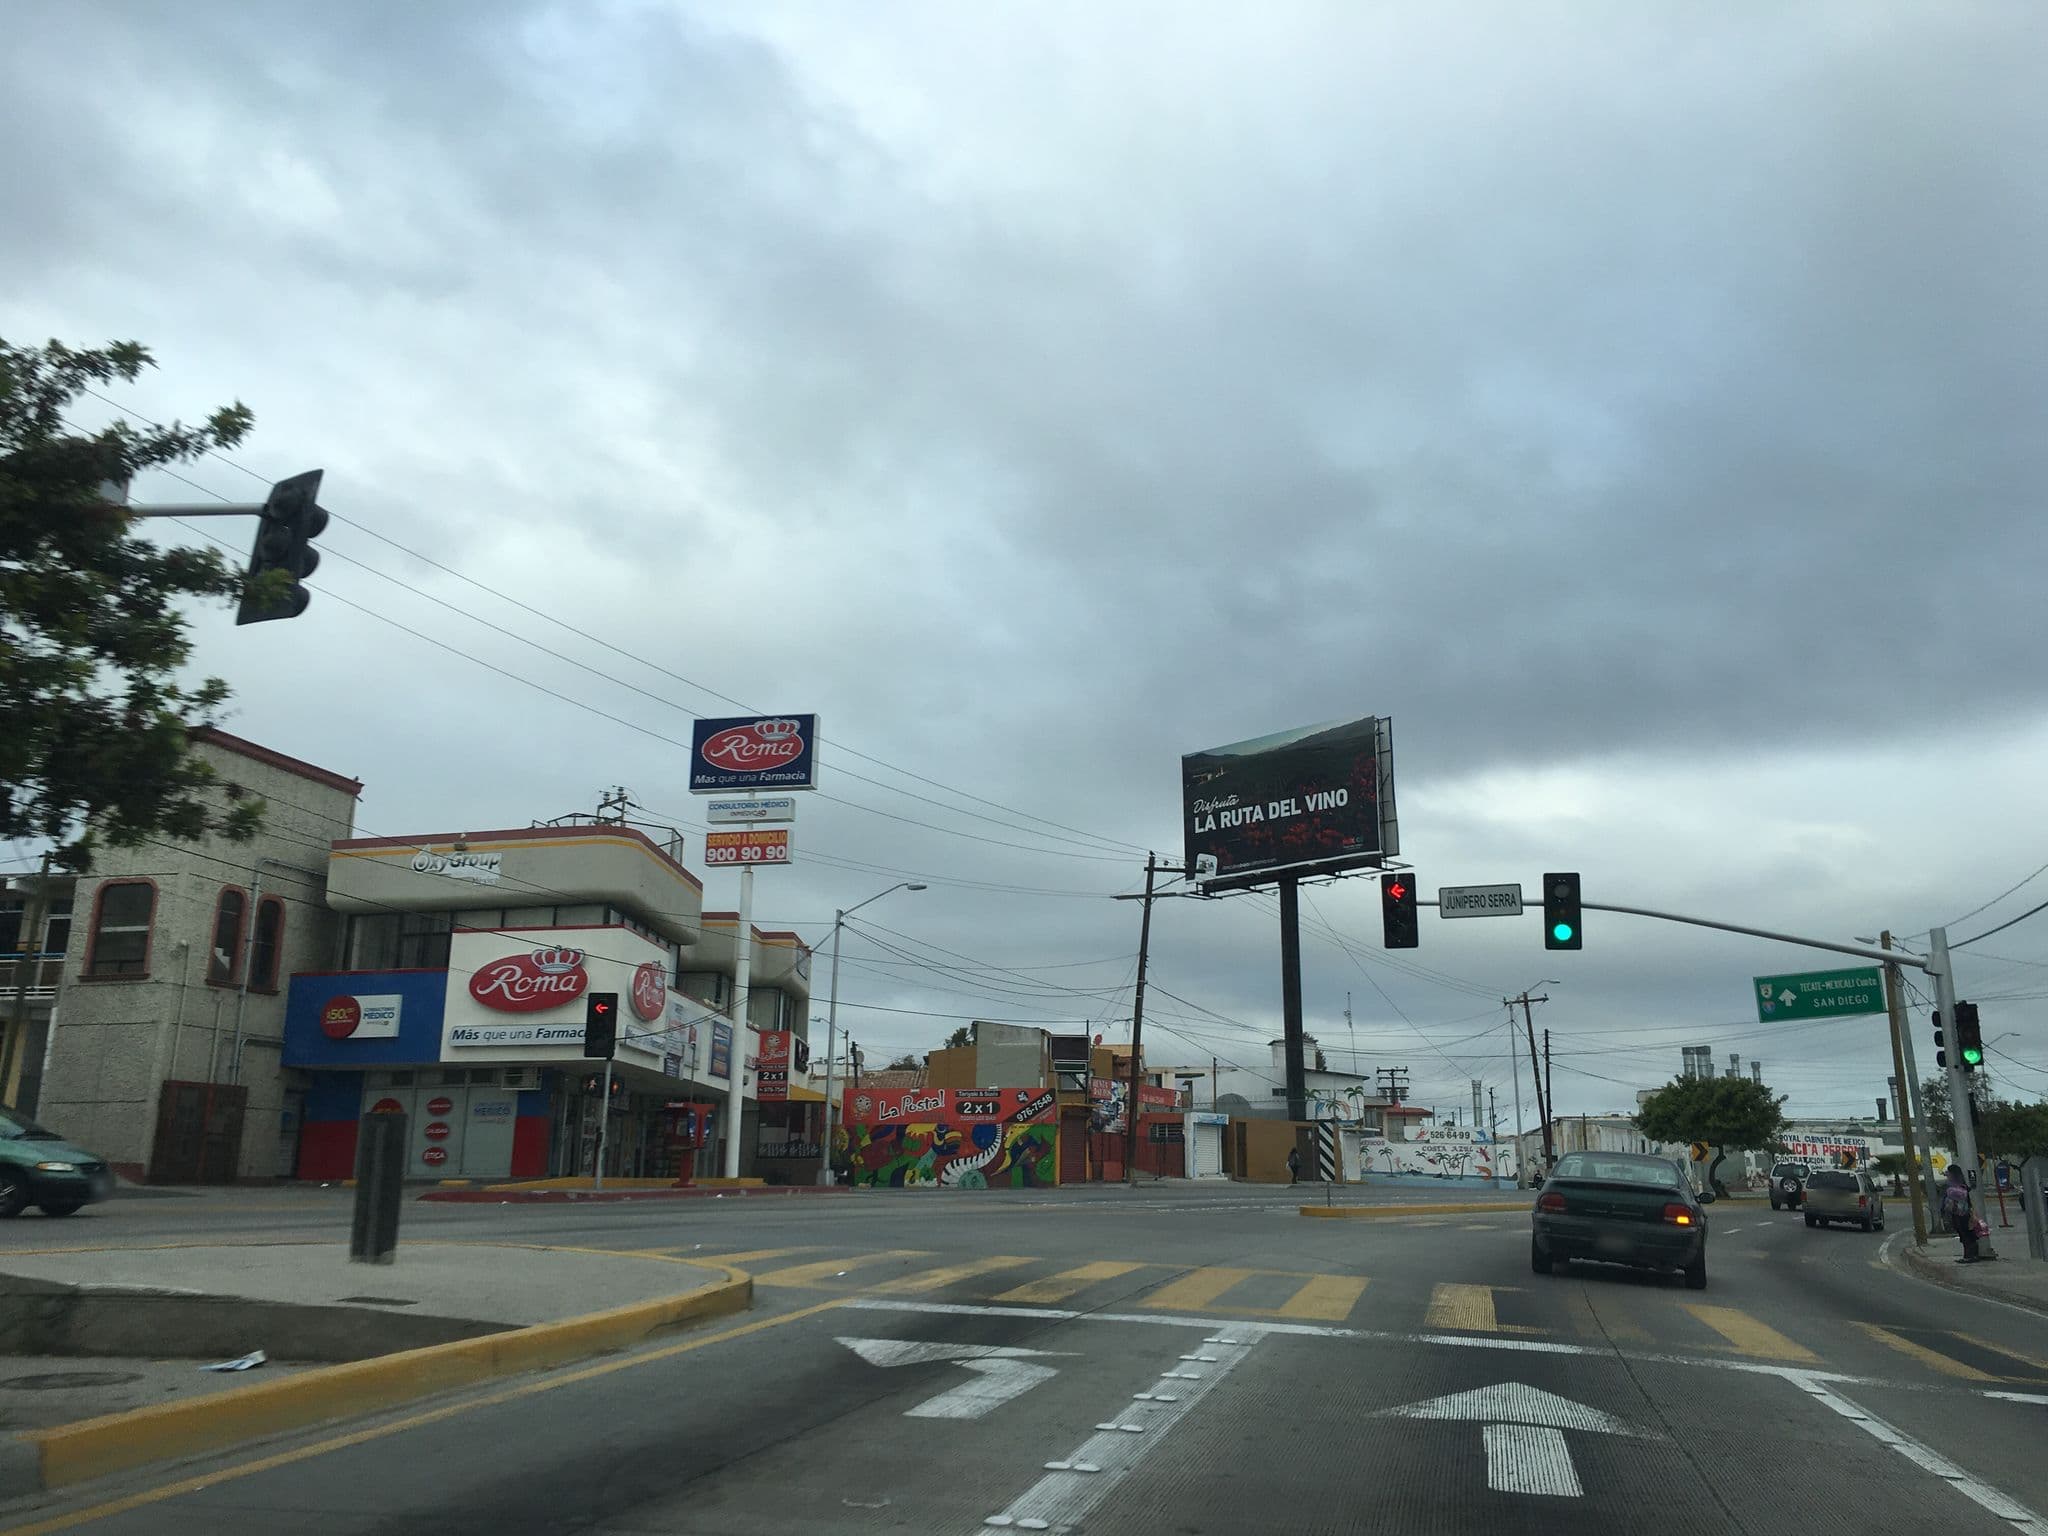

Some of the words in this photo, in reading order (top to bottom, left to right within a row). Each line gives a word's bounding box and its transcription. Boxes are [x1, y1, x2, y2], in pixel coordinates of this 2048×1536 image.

[710, 735, 794, 762] Roma
[718, 774, 737, 784] que
[739, 774, 757, 782] una
[708, 802, 759, 810] CONSULTORIO
[1193, 794, 1240, 815] Disfruta
[1195, 815, 1216, 834] LA
[1220, 805, 1264, 828] RUTA
[1268, 797, 1302, 819] DEL
[1304, 788, 1349, 812] VINO
[708, 835, 740, 846] SERVICIO
[742, 834, 748, 845] A
[749, 831, 787, 844] DOMICILIO
[707, 848, 737, 862] 900
[741, 846, 762, 860] 90
[765, 845, 786, 859] 90
[1445, 894, 1487, 909] JUNIPERO
[1488, 893, 1517, 908] SERRA
[477, 965, 577, 1001] Roma
[1813, 997, 1835, 1008] SAN
[1838, 994, 1869, 1006] DIEGO
[452, 1027, 479, 1040] Más
[483, 1030, 507, 1040] que
[509, 1028, 533, 1039] una
[536, 1026, 586, 1040] Farmac
[763, 1072, 769, 1080] 2
[879, 1101, 900, 1120] La
[901, 1089, 945, 1116] Postal
[963, 1102, 971, 1113] 2
[975, 1105, 982, 1113] x
[986, 1102, 993, 1113] 1
[1016, 1093, 1053, 1121] 976-7548
